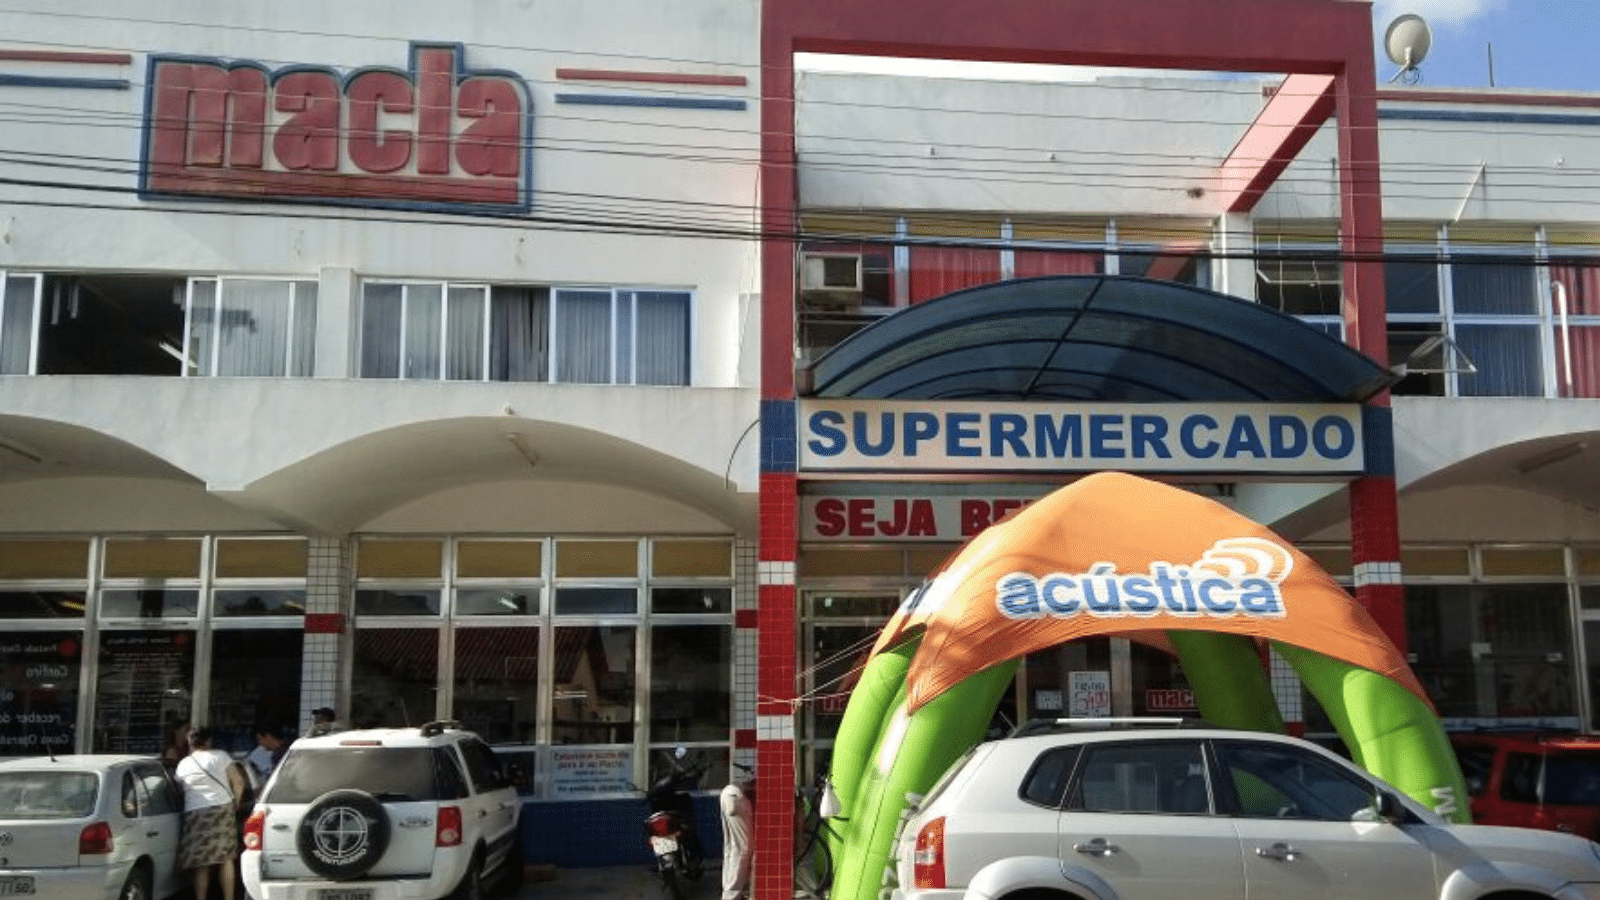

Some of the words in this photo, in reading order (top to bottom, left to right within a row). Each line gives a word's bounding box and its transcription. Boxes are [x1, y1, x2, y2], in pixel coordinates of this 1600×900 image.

[148, 48, 521, 203] macla
[807, 411, 1356, 460] SUPERMERCADO
[814, 498, 937, 537] SEJA
[1001, 565, 1281, 615] acústica
